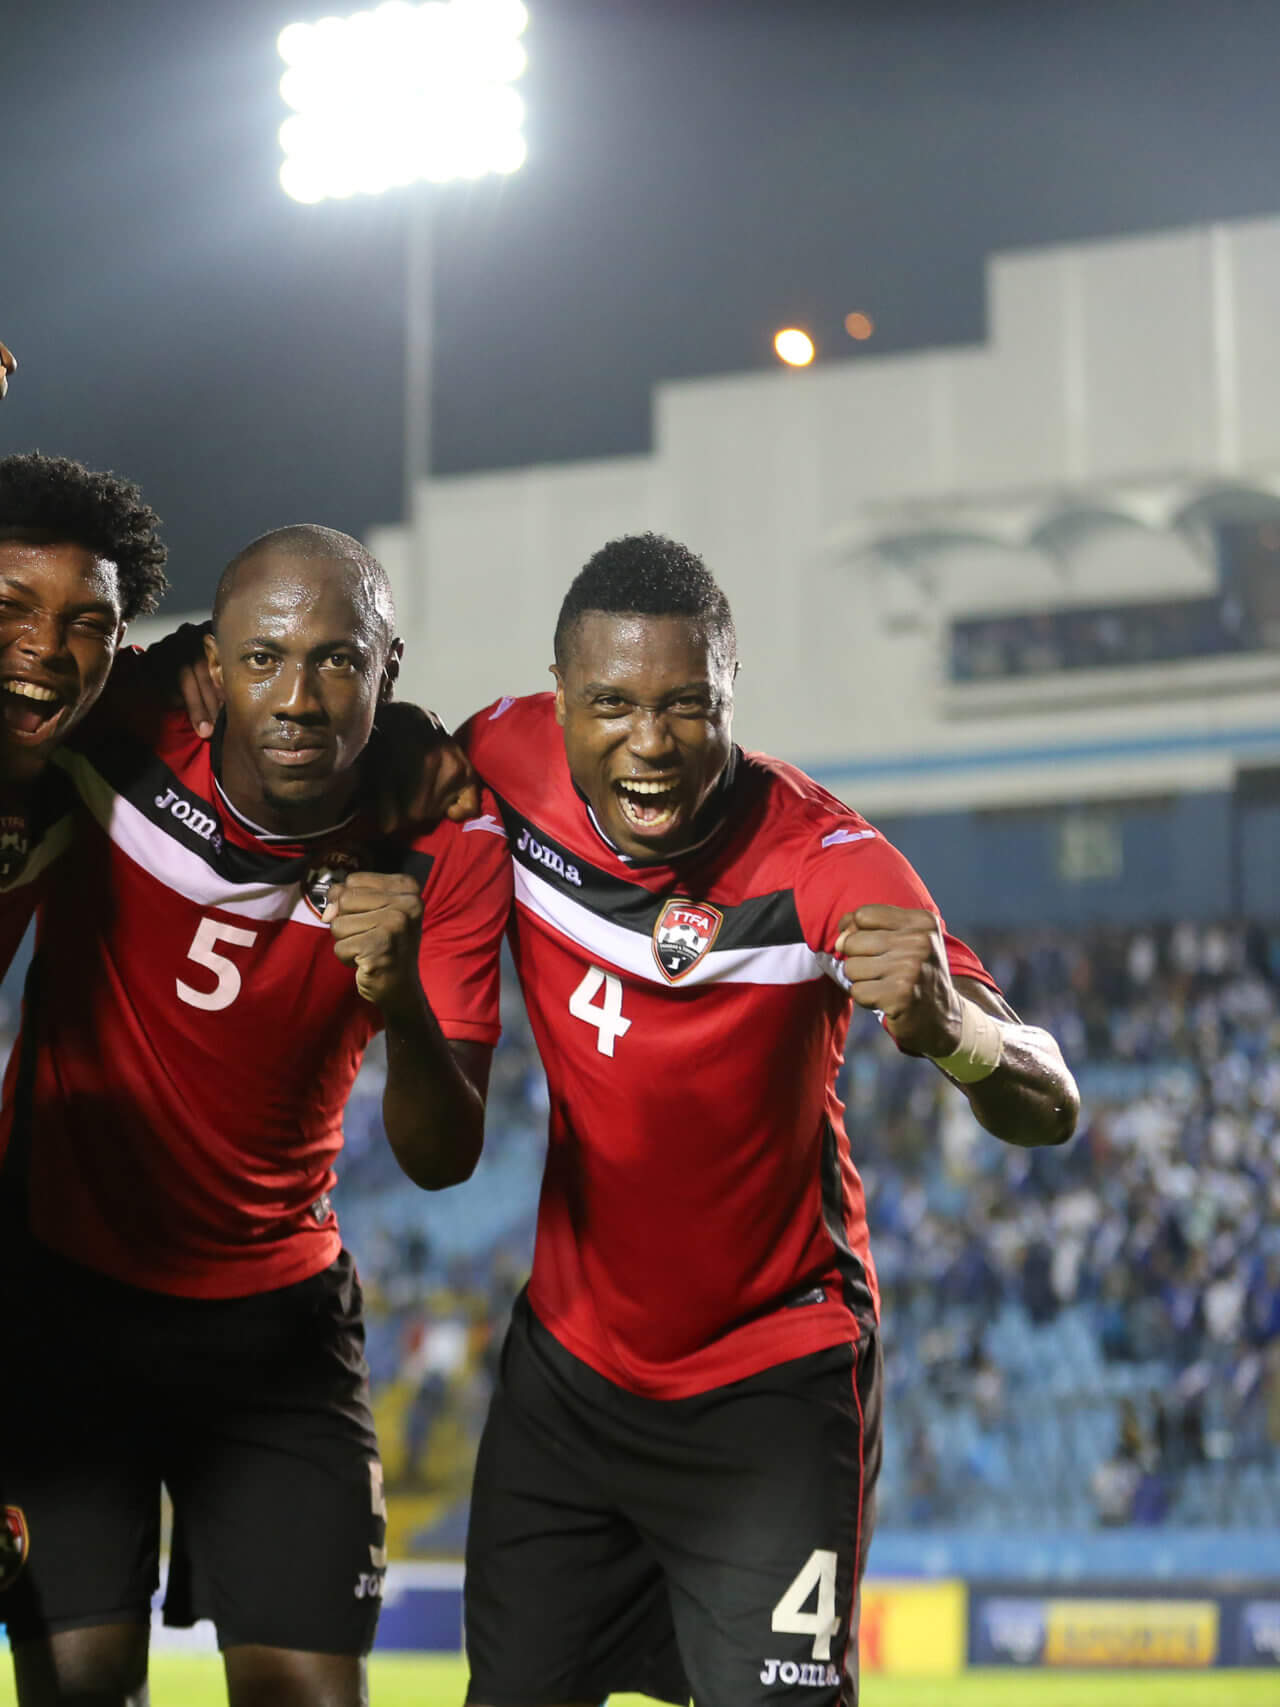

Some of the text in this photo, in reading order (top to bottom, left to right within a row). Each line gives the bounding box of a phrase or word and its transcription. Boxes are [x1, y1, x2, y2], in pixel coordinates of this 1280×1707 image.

[517, 827, 582, 887] Joma
[175, 917, 258, 1012] 5
[672, 910, 710, 931] TTFA
[568, 965, 632, 1058] 4
[771, 1548, 842, 1661] 4
